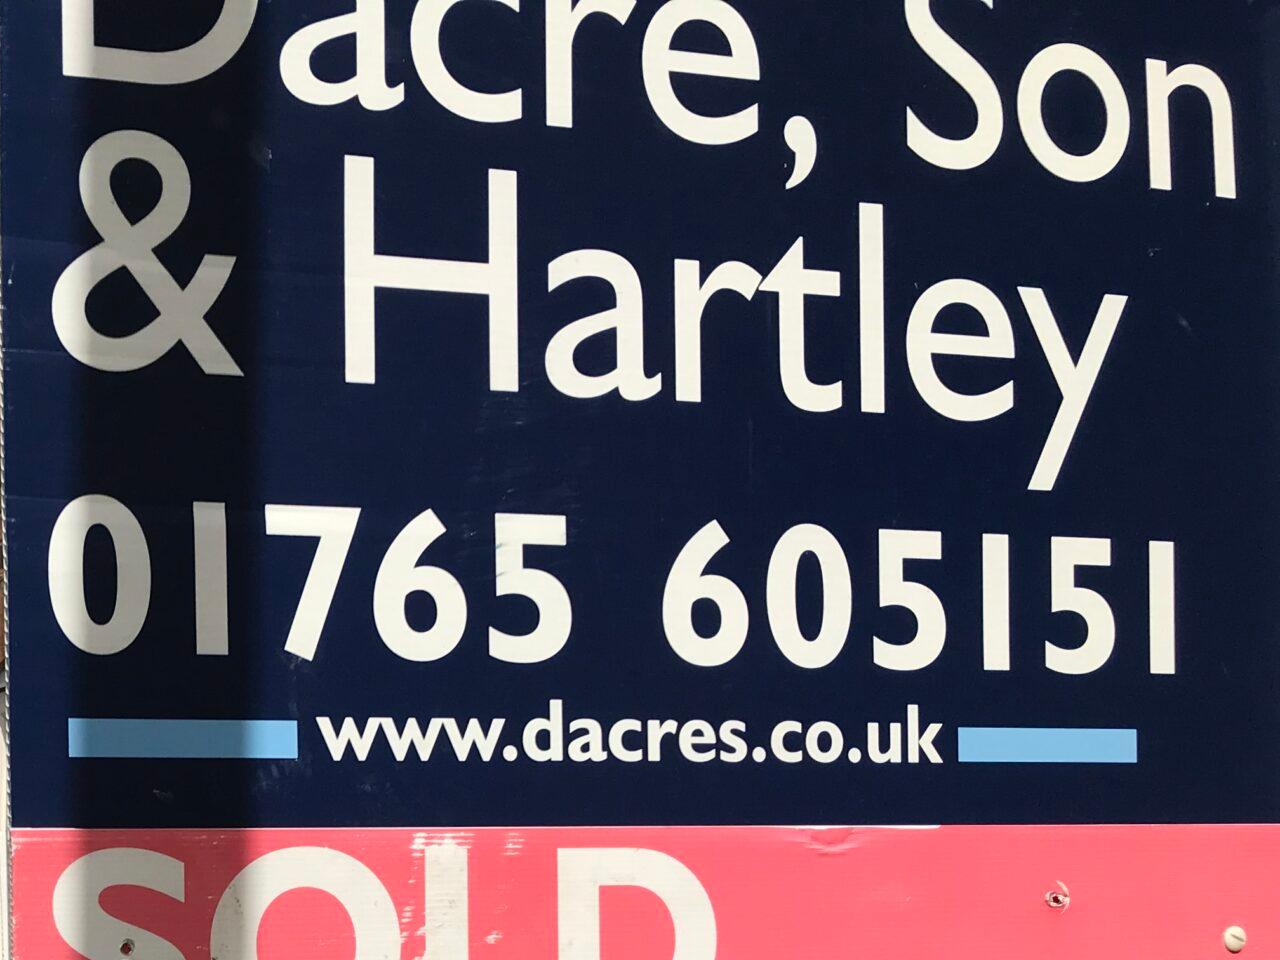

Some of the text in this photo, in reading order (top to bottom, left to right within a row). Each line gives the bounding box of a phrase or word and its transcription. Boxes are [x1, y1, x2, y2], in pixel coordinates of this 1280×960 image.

[904, 0, 1237, 199] Son
[52, 130, 1128, 491] & Hartley
[48, 495, 1176, 674] 01765 605151
[316, 699, 943, 763] www.dacres.co.uk
